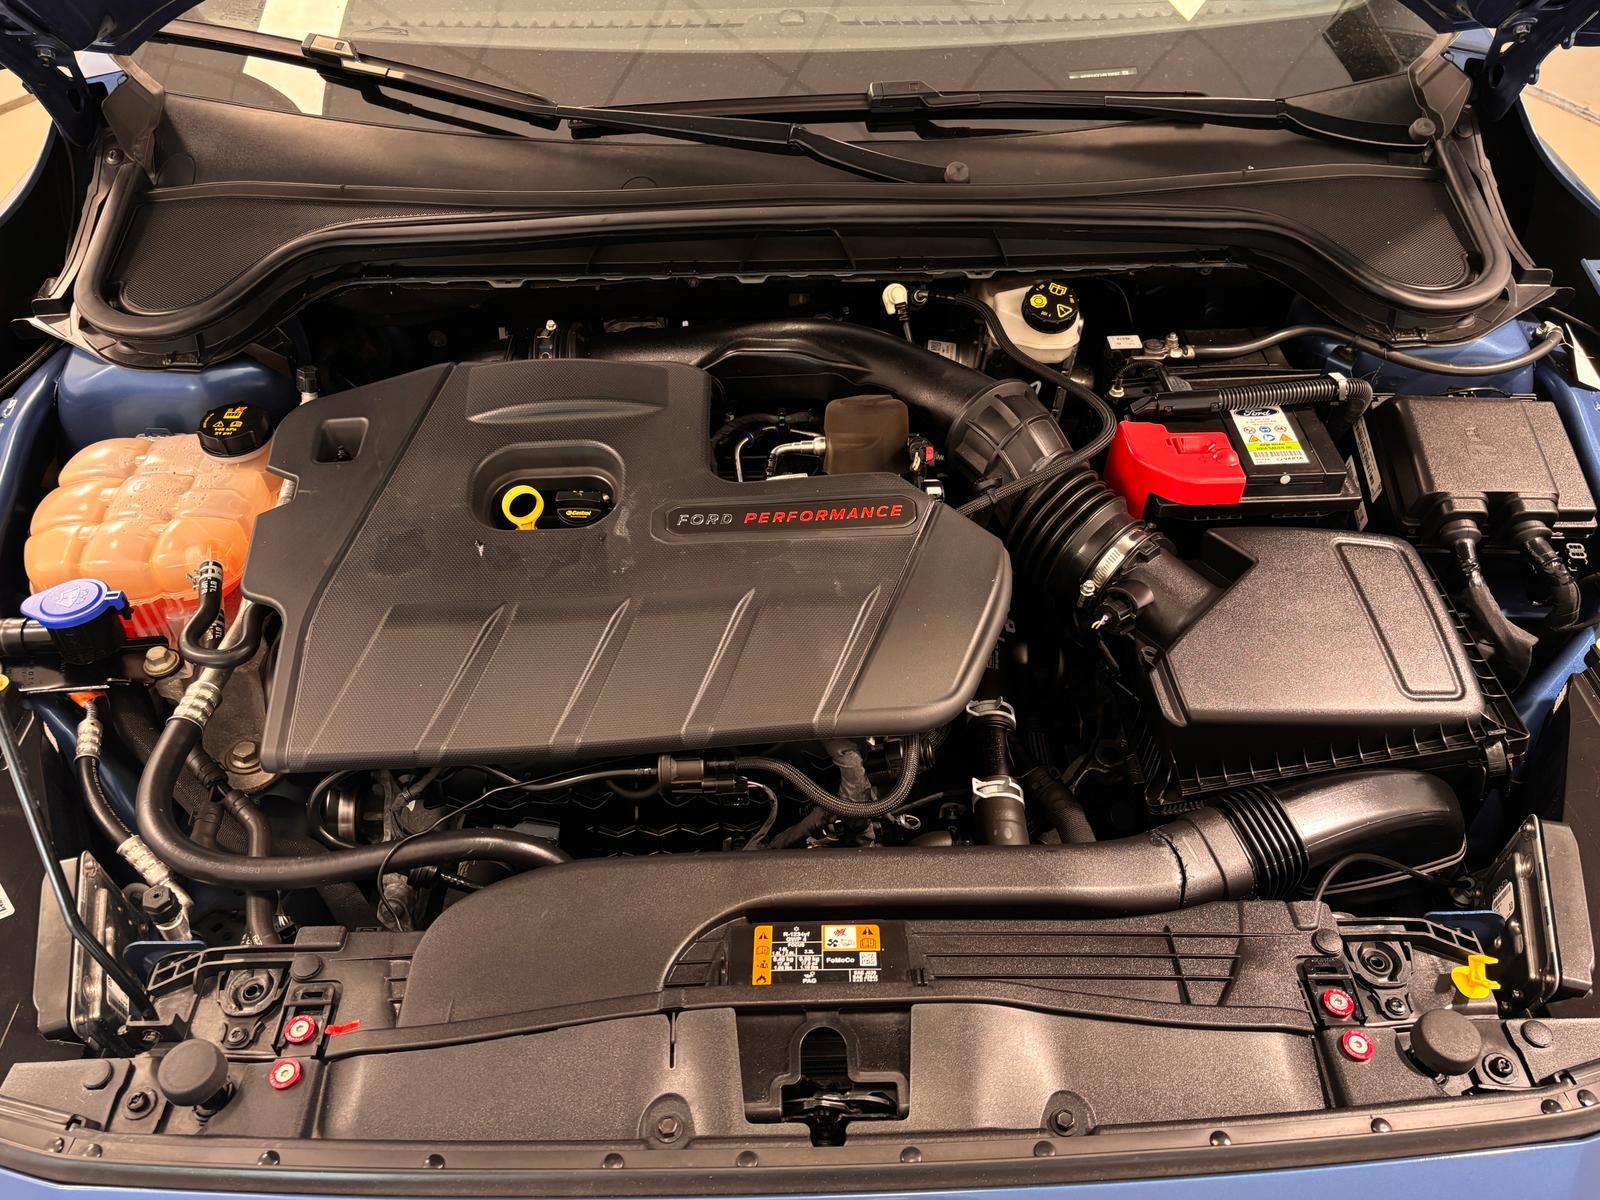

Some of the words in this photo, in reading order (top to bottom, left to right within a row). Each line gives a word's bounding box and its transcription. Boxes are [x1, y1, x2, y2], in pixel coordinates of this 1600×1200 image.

[1243, 408, 1271, 417] Ford
[676, 513, 733, 526] FORD
[744, 504, 903, 524] PERFORMANCE
